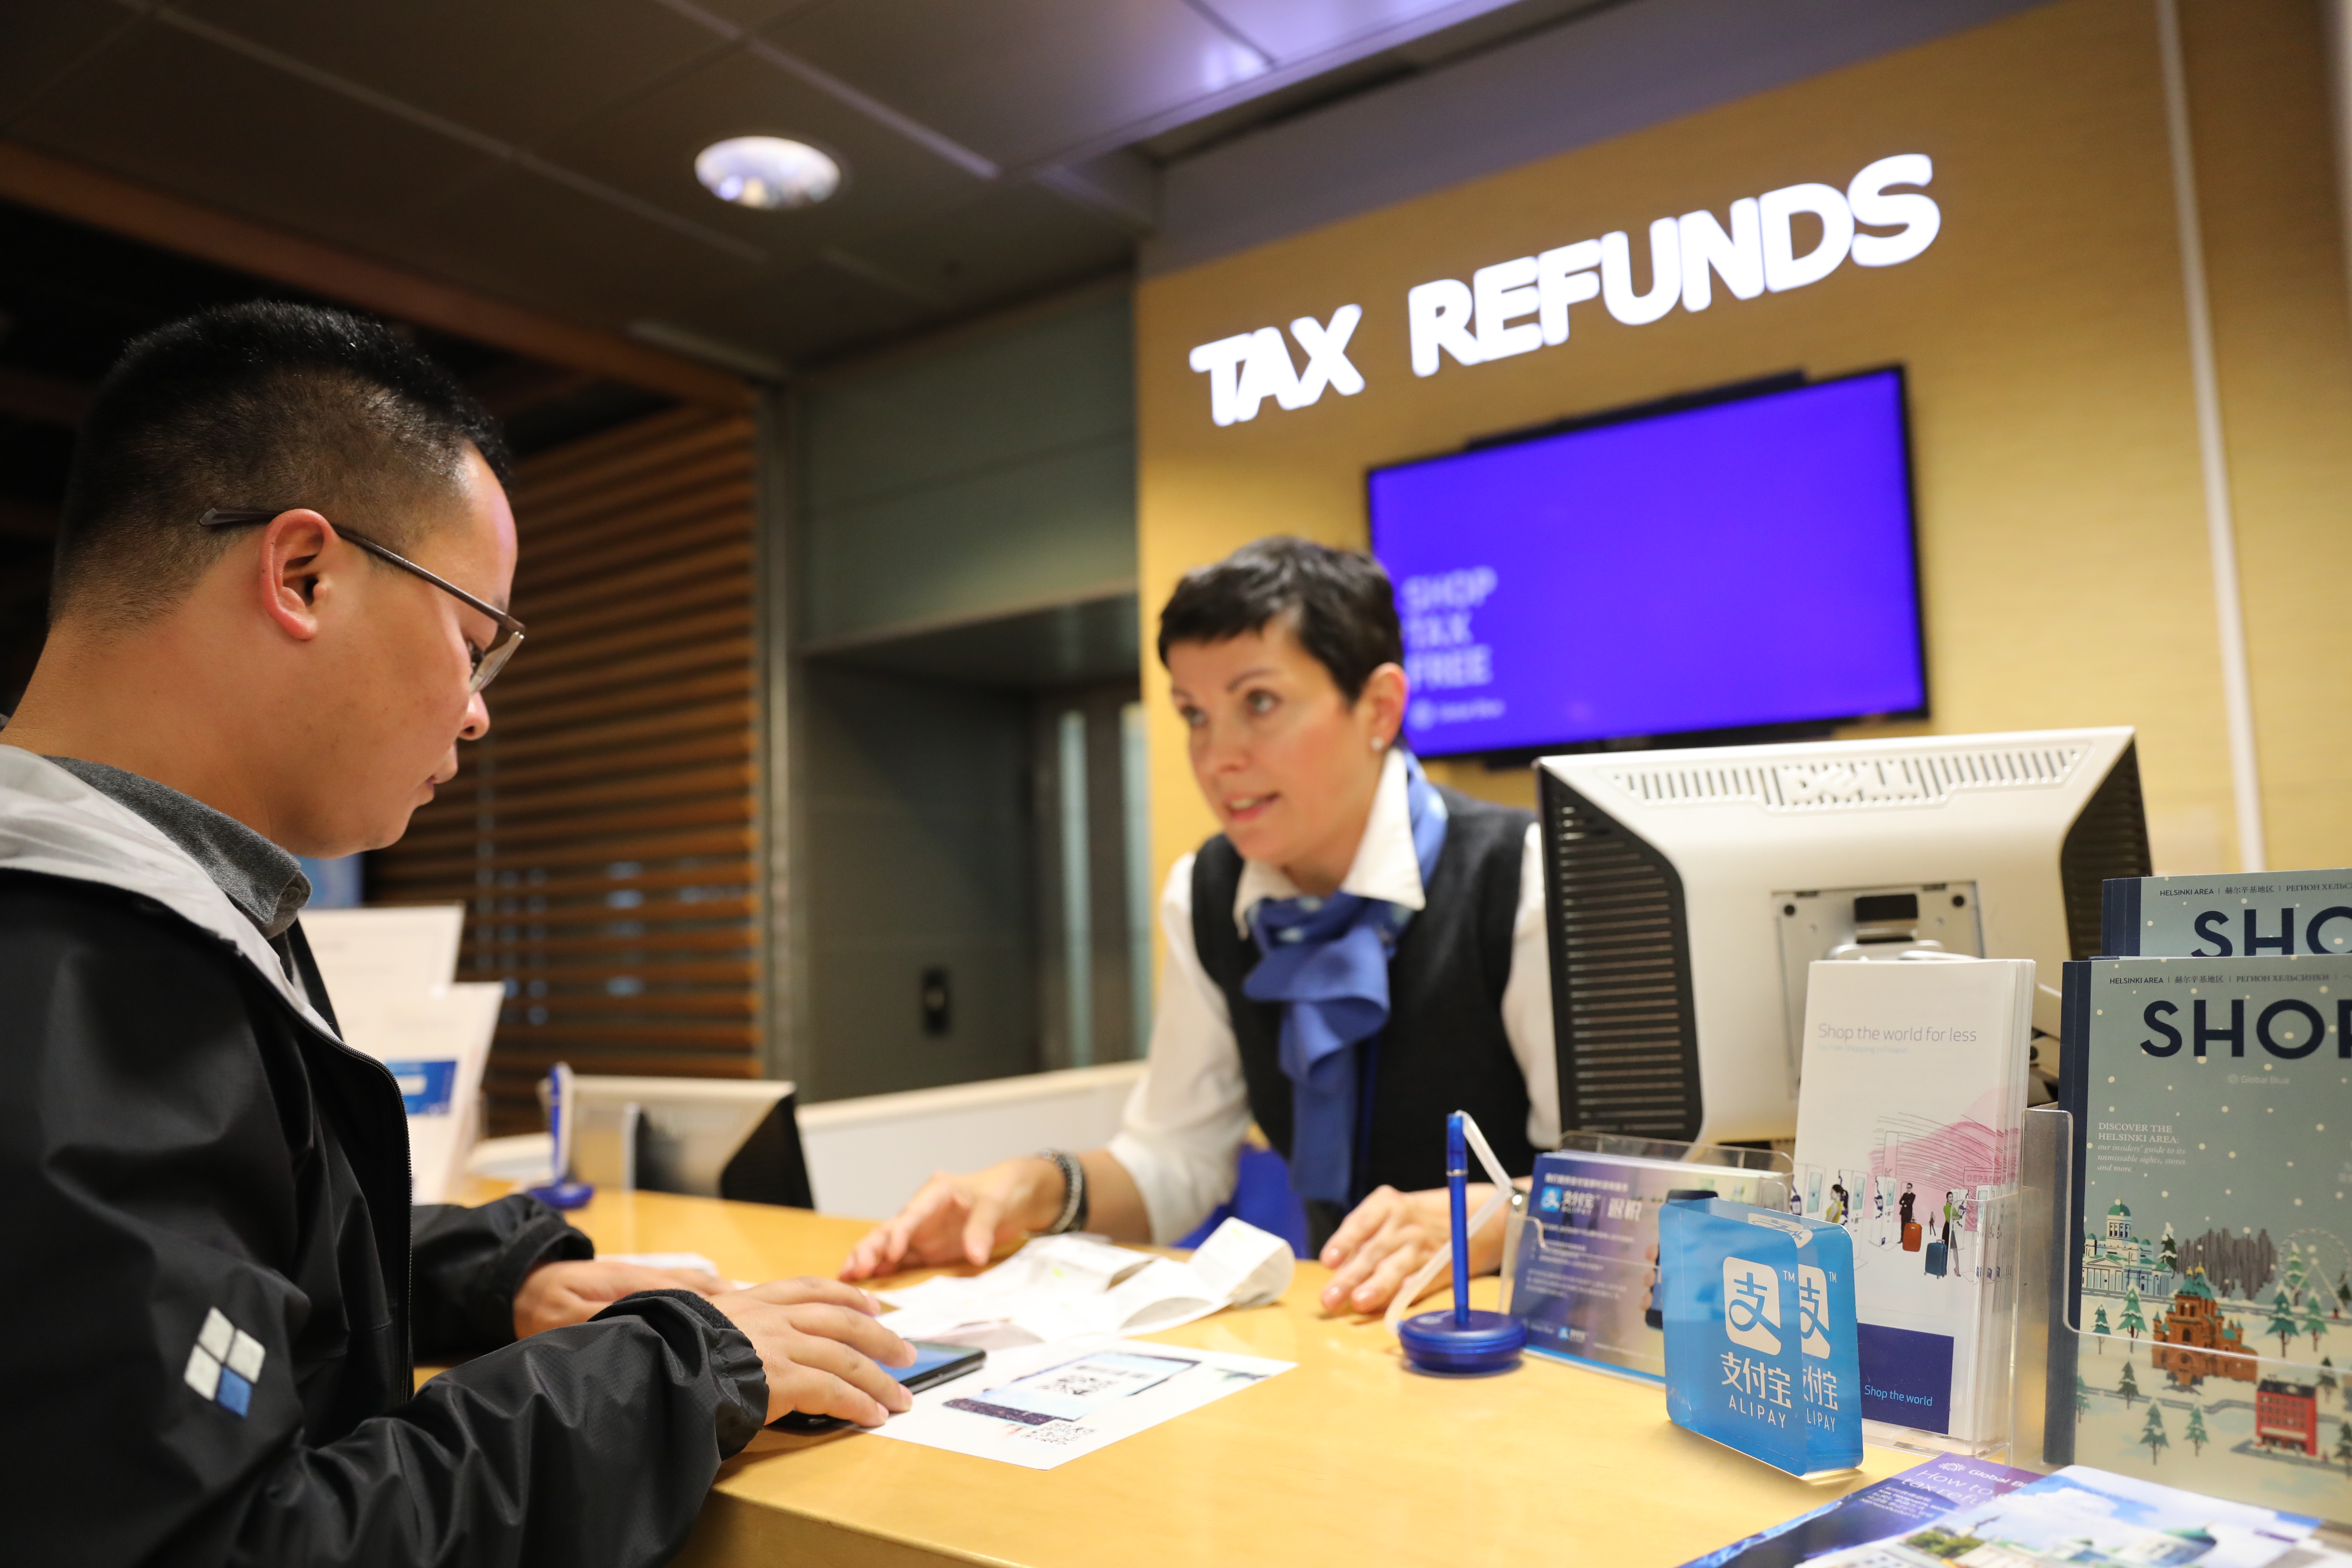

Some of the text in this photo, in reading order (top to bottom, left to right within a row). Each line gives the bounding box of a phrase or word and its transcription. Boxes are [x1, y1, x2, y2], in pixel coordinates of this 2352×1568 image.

[1190, 153, 1941, 427] TAX REFUNDS
[1818, 1023, 1976, 1042] Shop the world for less
[2099, 1122, 2172, 1133] DISCOVER THE
[2098, 1133, 2179, 1143] HELSINKI AREA:
[2098, 1154, 2137, 1162] unmissable
[2144, 1145, 2165, 1154] guide
[1720, 1351, 1792, 1409] 支付宝
[1864, 1385, 1933, 1406] Shop the world
[1729, 1394, 1786, 1428] ALIPAY
[1807, 1408, 1835, 1432] LIPAY
[1901, 1477, 1937, 1492] tax
[1916, 1470, 1994, 1495] How to
[1968, 1469, 2011, 1483] Global
